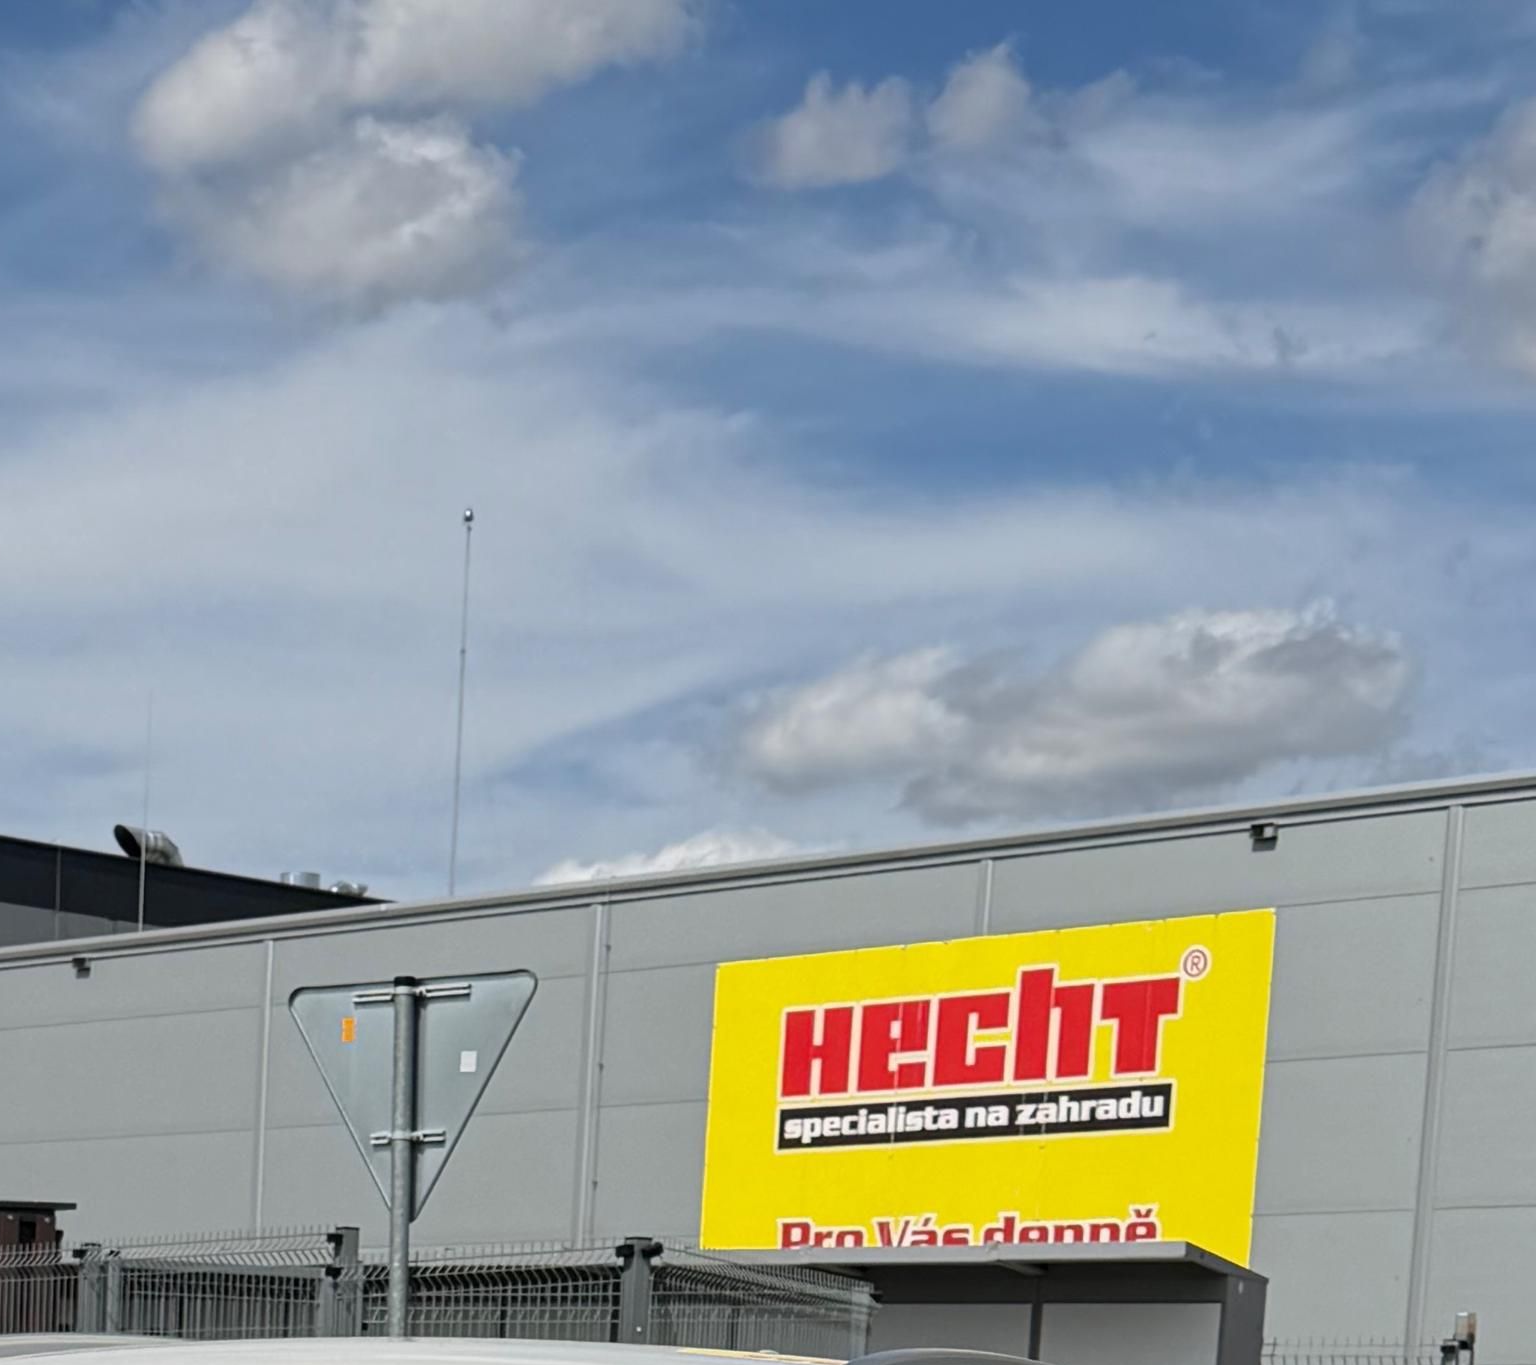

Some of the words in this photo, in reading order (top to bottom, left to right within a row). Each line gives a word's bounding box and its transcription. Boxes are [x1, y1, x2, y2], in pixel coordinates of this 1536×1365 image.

[783, 1106, 959, 1144] specialista
[964, 1104, 1010, 1128] na
[1015, 1090, 1164, 1125] zahradu
[782, 1222, 864, 1249] Pro
